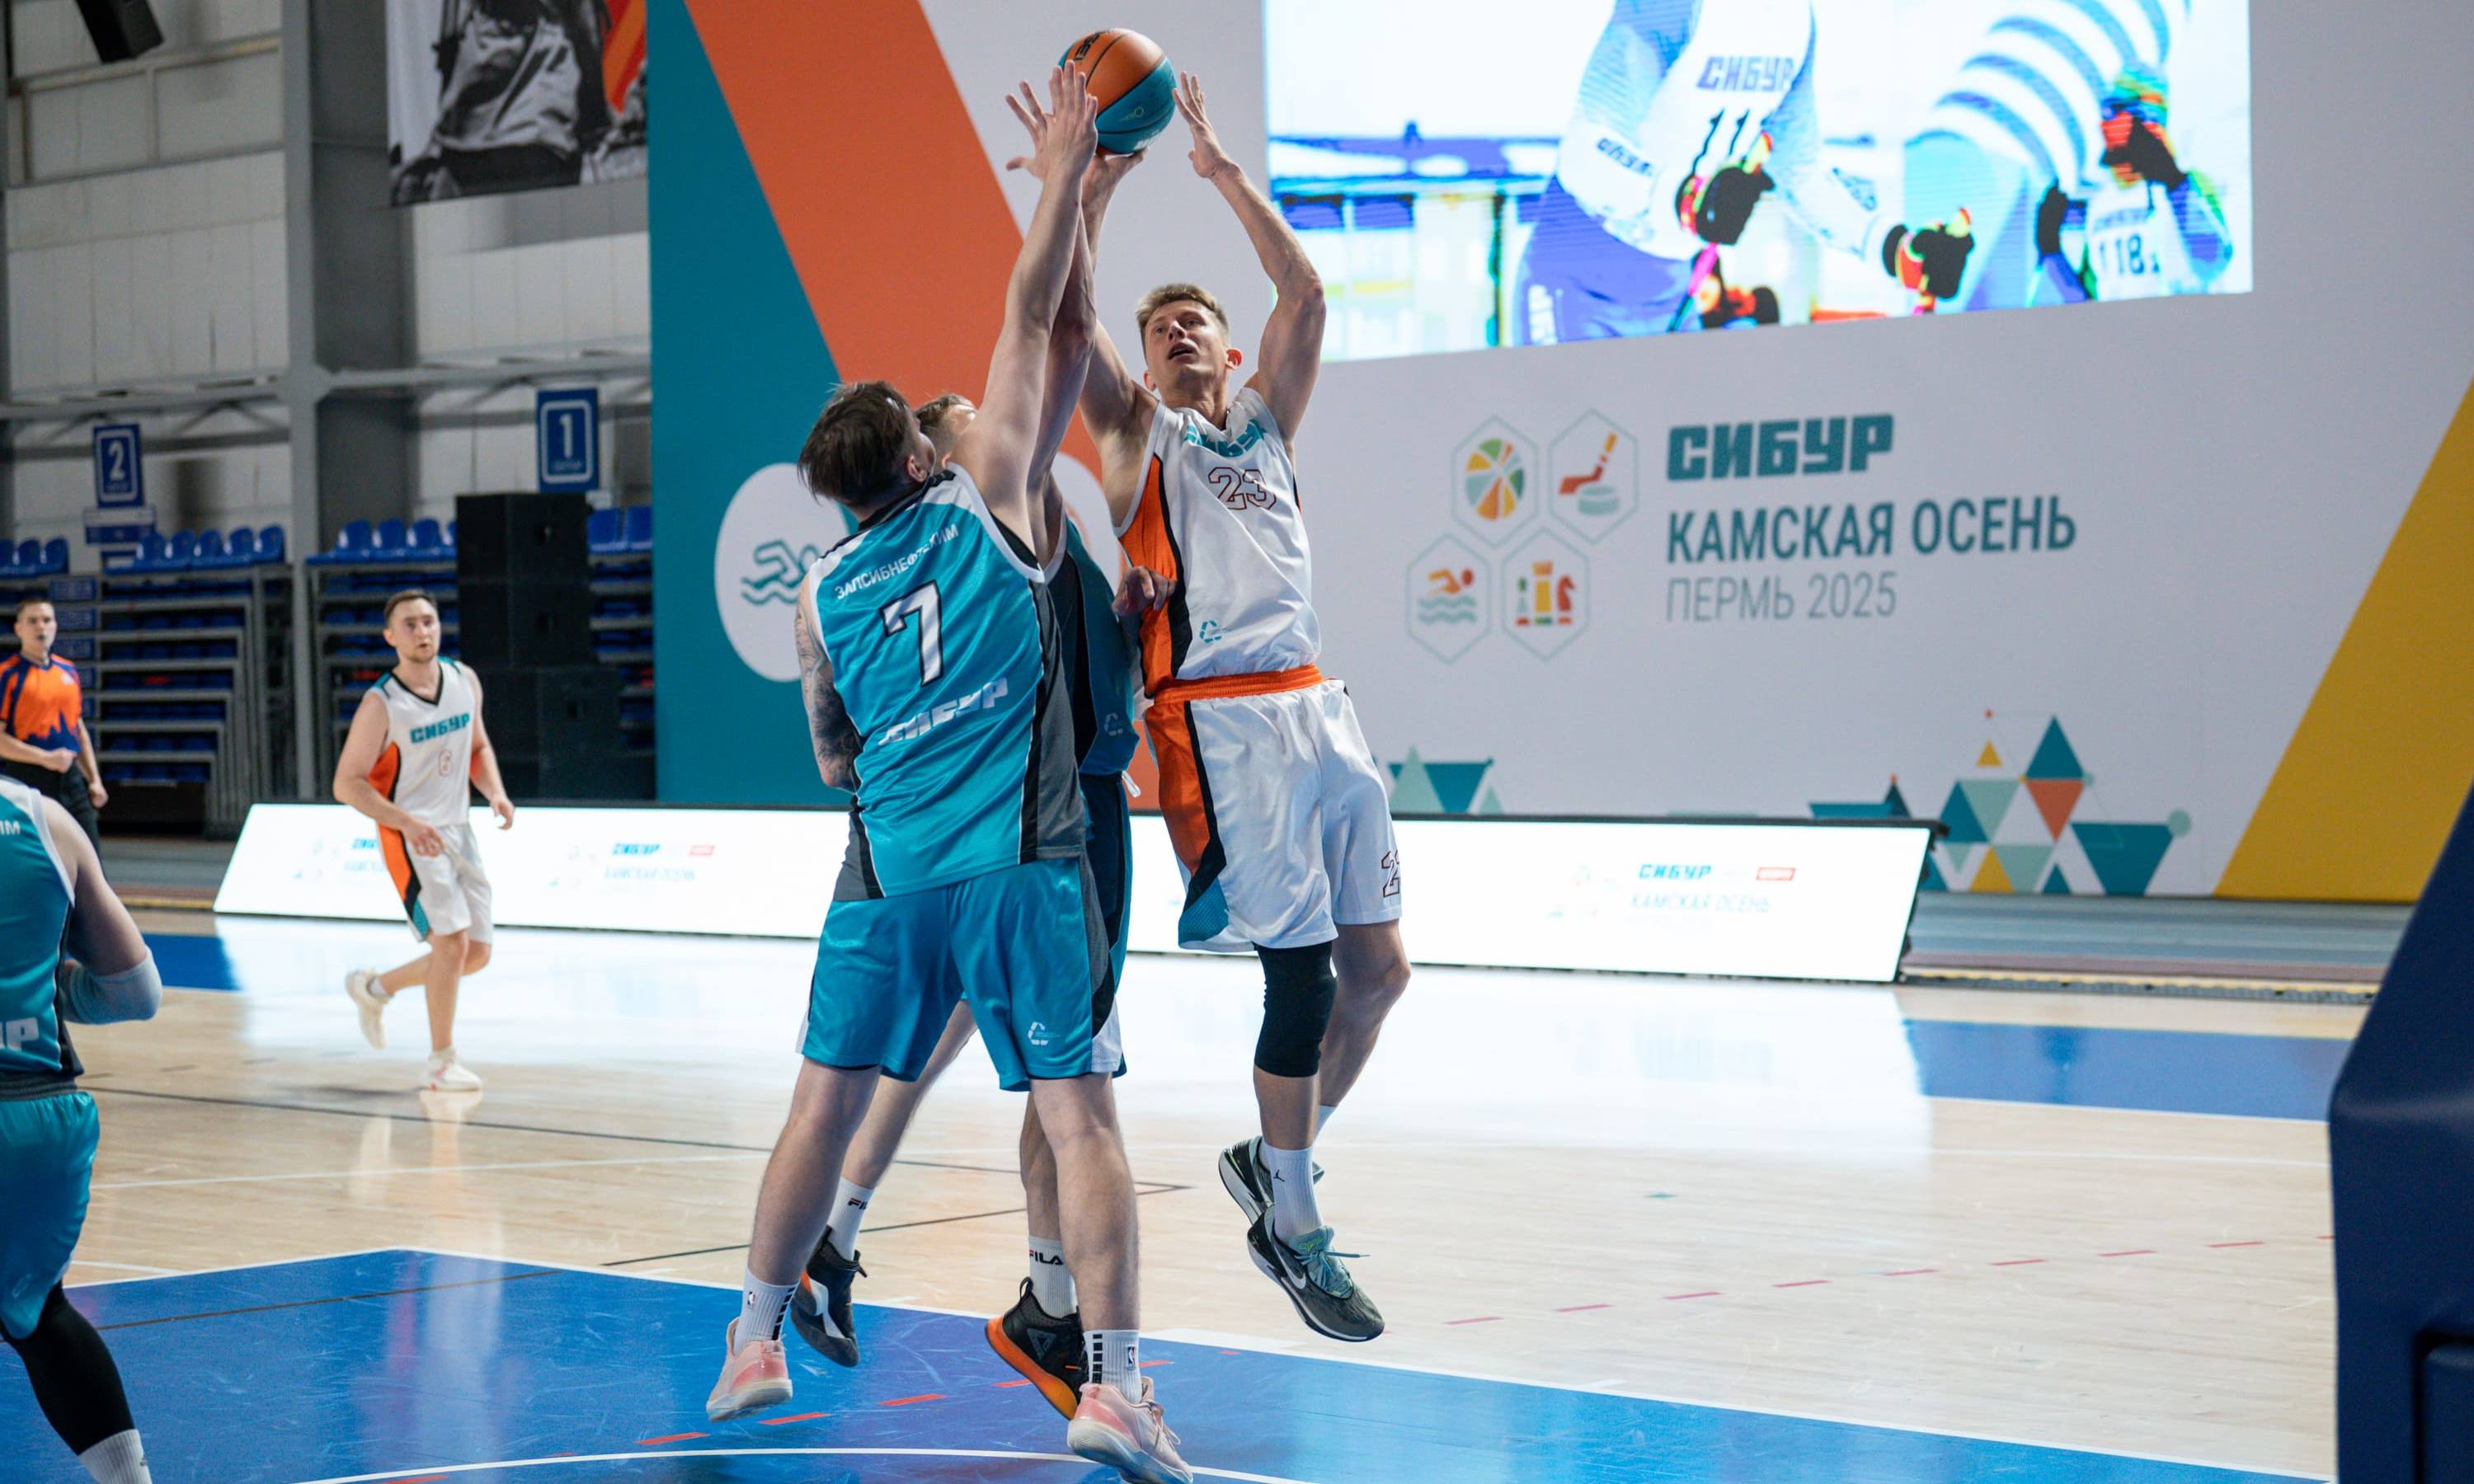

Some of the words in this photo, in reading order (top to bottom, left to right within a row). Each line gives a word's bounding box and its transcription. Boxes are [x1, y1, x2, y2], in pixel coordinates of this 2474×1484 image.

[559, 413, 573, 458] 1
[1667, 414, 1894, 481] СИБУР
[108, 440, 125, 481] 2
[1208, 466, 1277, 510] 23
[1667, 501, 1894, 564] КАМСКАЯ
[1912, 495, 2077, 555] ОСЕНЬ
[1666, 576, 1795, 622] ПЕРМЬ
[1807, 571, 1898, 619] 2025
[878, 580, 943, 688] 7
[410, 712, 470, 744] СИБУР
[1638, 863, 1712, 881] СИБУР
